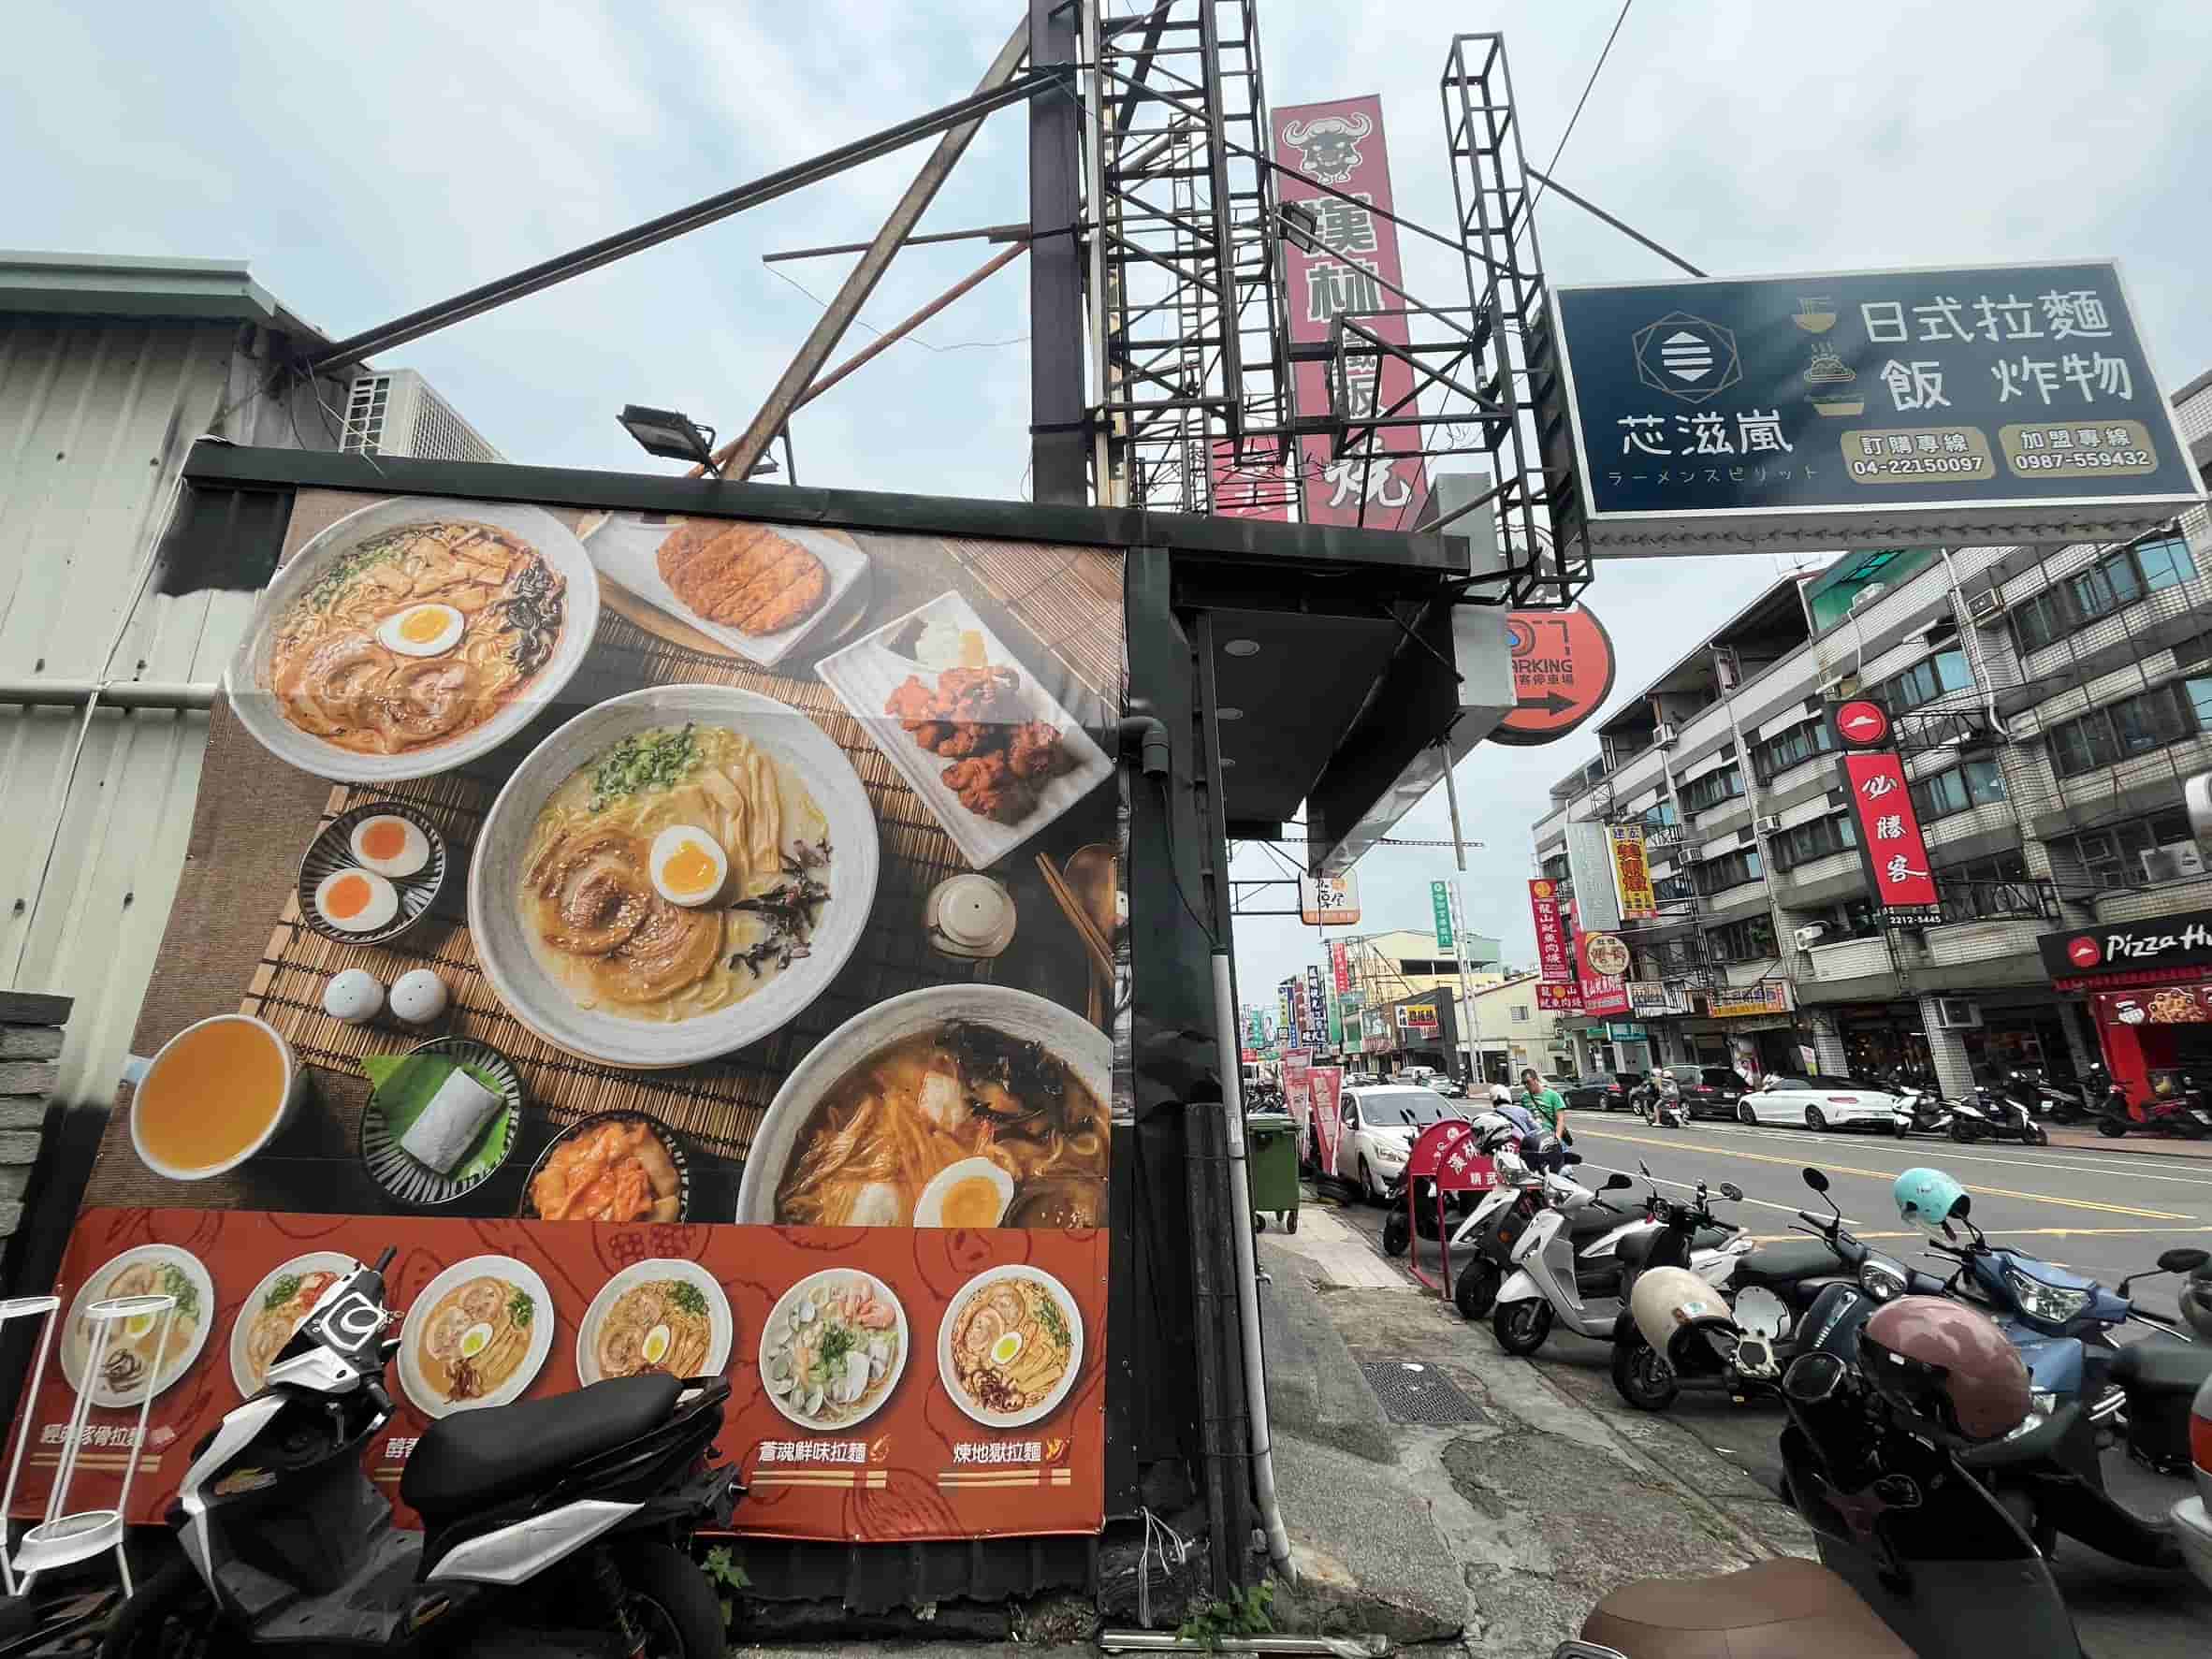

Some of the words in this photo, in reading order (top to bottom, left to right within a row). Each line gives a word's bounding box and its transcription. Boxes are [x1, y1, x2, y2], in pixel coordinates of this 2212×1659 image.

[1858, 289, 2112, 343] 日式拉麵
[1879, 358, 1953, 413] 飯
[1990, 351, 2134, 406] 炸物
[1616, 408, 1794, 458] 芯滋嵐
[1861, 432, 1971, 457] 訂購專線
[2020, 428, 2132, 451] 加盟專線
[1854, 455, 1985, 477] 04-22150097
[2015, 448, 2150, 471] 0987-559432
[1608, 465, 1817, 486] ラーメンスピリット
[1861, 774, 1928, 882] 必勝客
[2106, 934, 2178, 962] Pizza
[759, 1441, 867, 1463] 蒼魂鮮味拉麵
